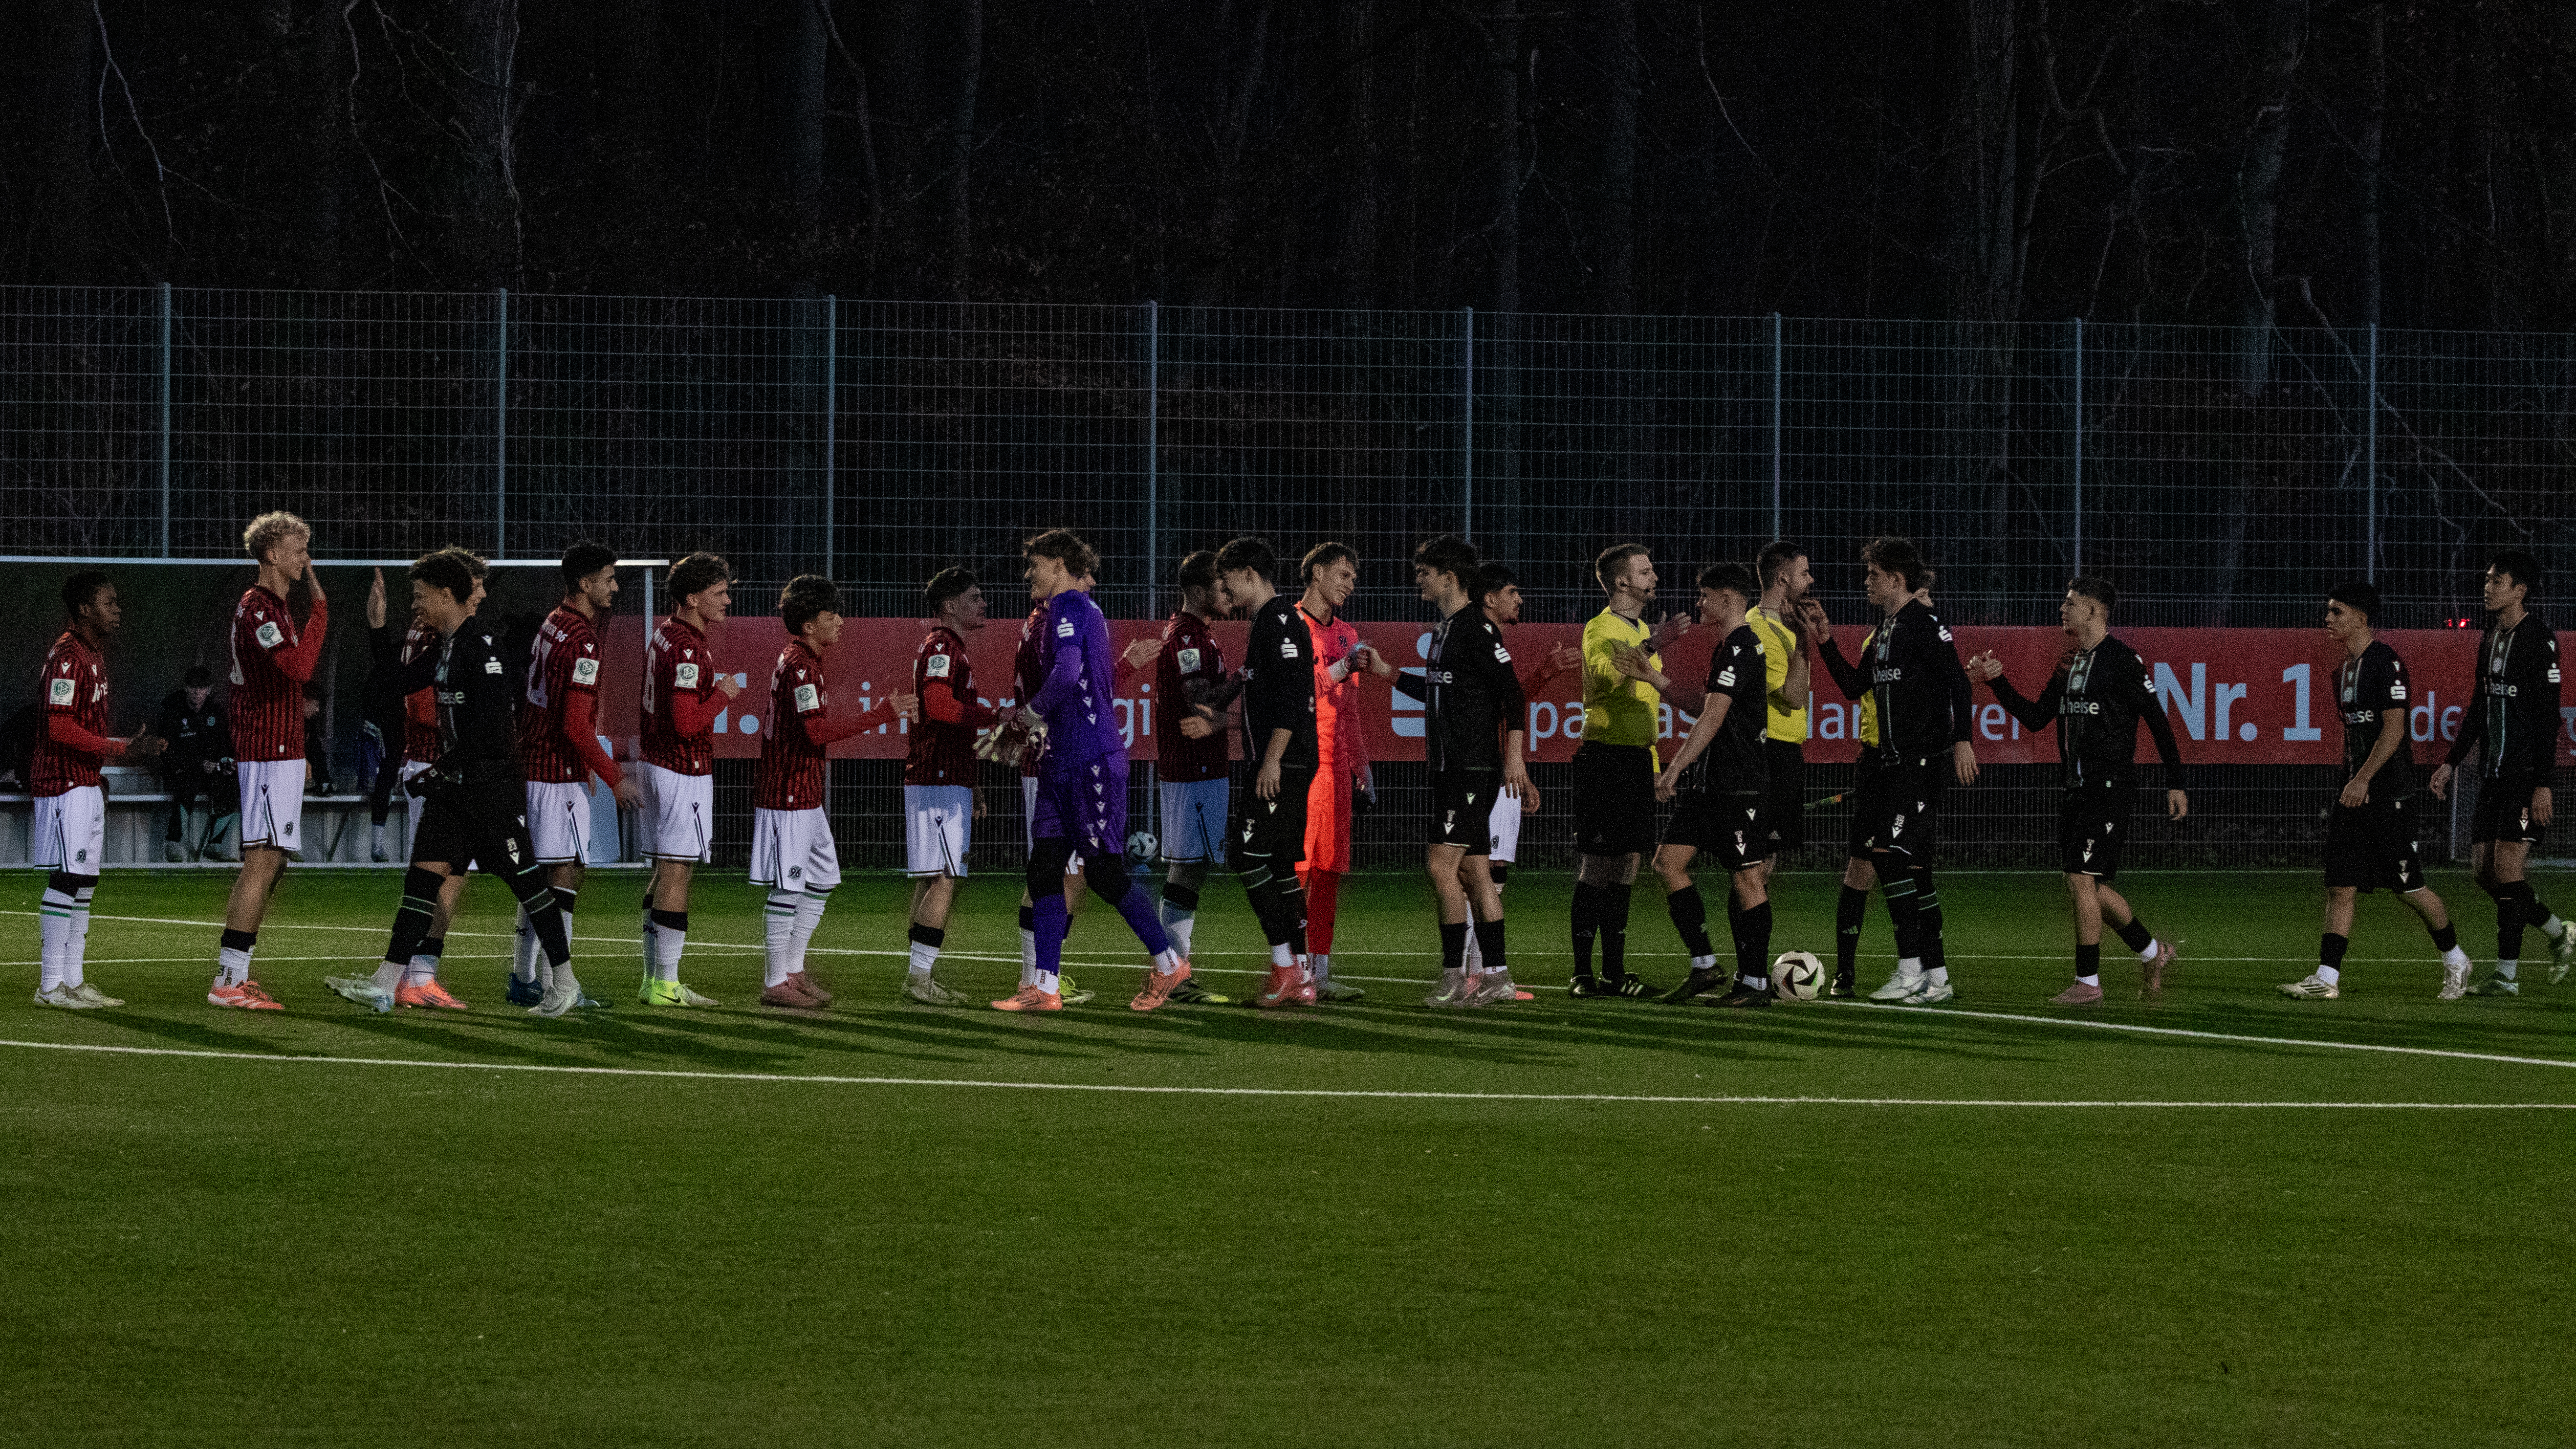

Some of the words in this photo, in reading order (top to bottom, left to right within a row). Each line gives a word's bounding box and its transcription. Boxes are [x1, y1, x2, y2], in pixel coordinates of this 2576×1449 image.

[555, 630, 568, 642] 96
[2154, 662, 2258, 742] Nr.
[2283, 663, 2321, 741] 1
[788, 867, 802, 879] 96
